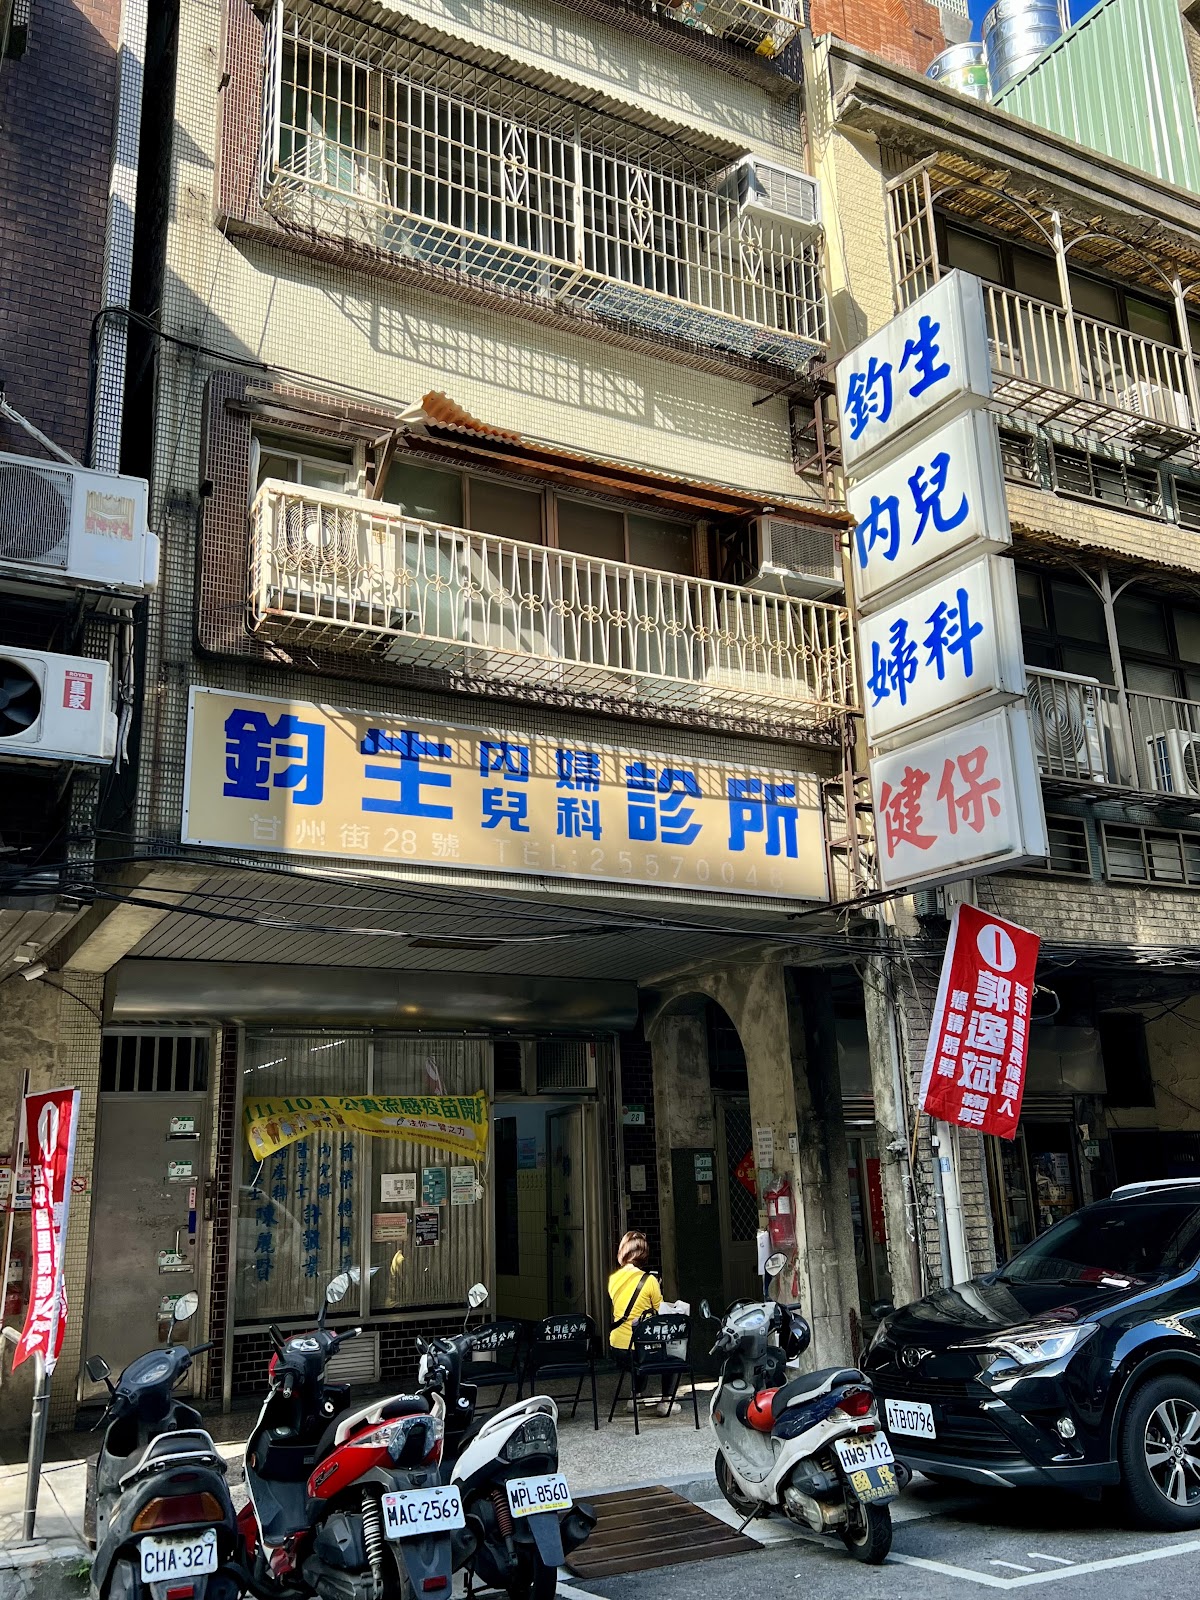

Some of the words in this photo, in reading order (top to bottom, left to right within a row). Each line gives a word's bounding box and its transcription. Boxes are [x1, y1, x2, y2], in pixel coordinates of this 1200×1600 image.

[845, 316, 951, 440] 鈞生
[855, 452, 970, 568] 內兒
[69, 681, 86, 708] 皇家
[867, 588, 984, 707] 婦科
[880, 747, 1000, 858] 健保
[937, 989, 970, 1079] 懇請賜票
[957, 969, 1012, 1095] 郭逸斌
[997, 981, 1029, 1118] 延平里里長候選人
[176, 1167, 185, 1175] 28
[631, 1113, 640, 1122] 28
